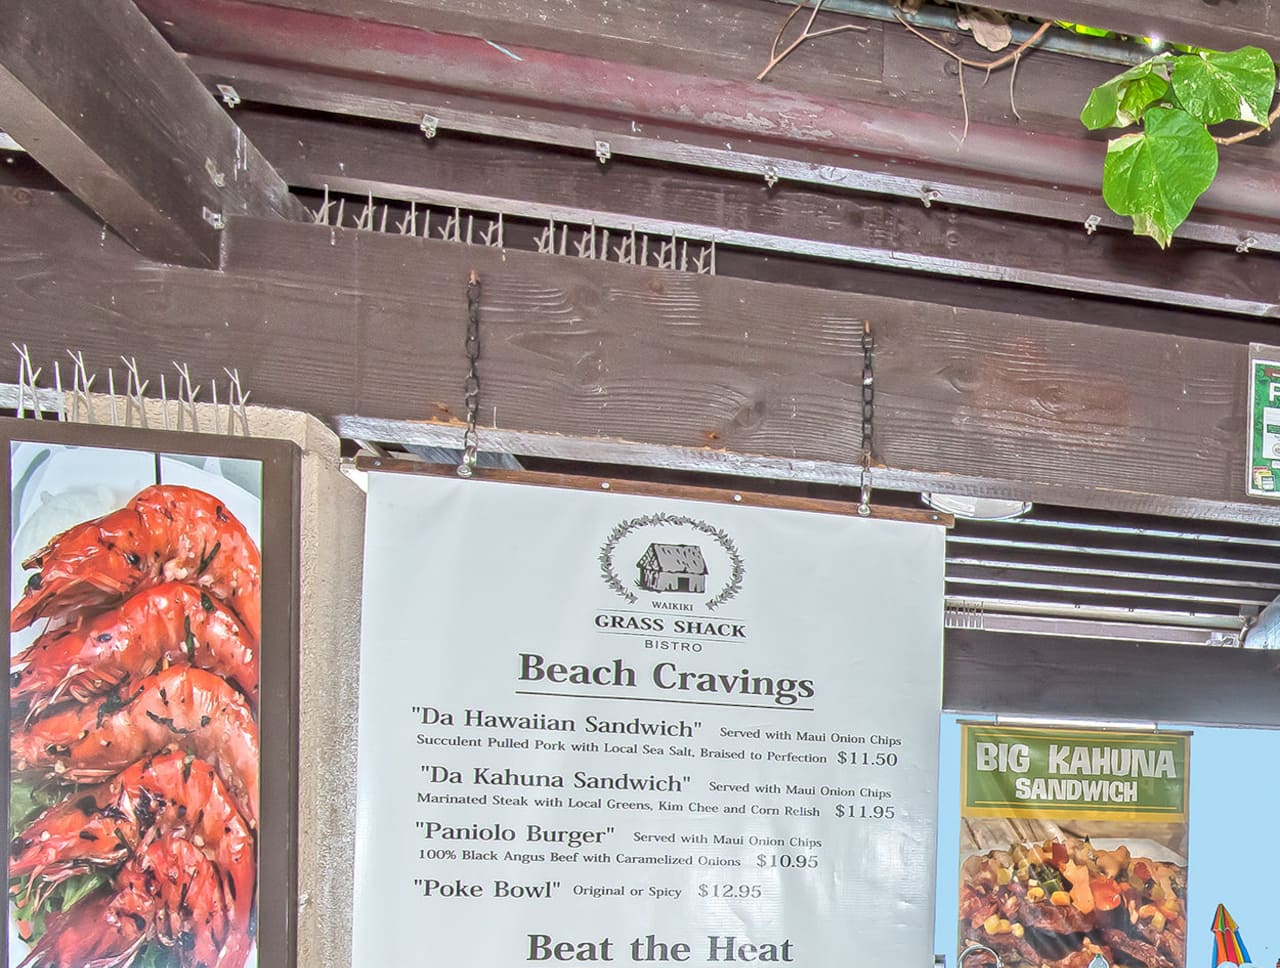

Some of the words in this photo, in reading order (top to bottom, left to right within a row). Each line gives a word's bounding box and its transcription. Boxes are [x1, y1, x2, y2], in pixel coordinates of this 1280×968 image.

[651, 600, 693, 611] WAIKIKI
[594, 614, 664, 634] GRASS
[673, 617, 746, 637] SHACK
[645, 639, 703, 652] BISTRO
[517, 653, 636, 686] Beach
[653, 662, 815, 705] Cravings
[411, 706, 453, 725] "Da
[463, 709, 575, 731] Hawaiian
[585, 715, 701, 737] Sandwich"
[719, 726, 760, 738] Served
[764, 730, 791, 740] with
[796, 731, 825, 741] Maui
[830, 732, 865, 743] Onion
[869, 734, 901, 747] Chips
[416, 733, 481, 746] Succulent
[487, 737, 528, 748] Pulled
[534, 739, 565, 750] Pork
[570, 742, 598, 752] with
[603, 742, 637, 753] Local
[642, 744, 664, 755] Sea
[668, 745, 694, 757] Salt,
[700, 747, 744, 759] Braised
[750, 751, 762, 760] to
[767, 751, 826, 763] Perfection
[837, 750, 897, 766] $11.50
[976, 742, 1030, 773] BIG
[1048, 744, 1177, 778] KAHUNA
[421, 765, 462, 783] "Da
[473, 767, 563, 787] Kahuna
[573, 771, 690, 792] Sandwich"
[708, 781, 749, 792] Served
[754, 783, 780, 793] with
[785, 784, 815, 795] Maui
[820, 786, 855, 796] Onion
[859, 787, 891, 800] Chips
[1015, 777, 1138, 802] SANDWICH
[417, 792, 486, 804] Marinated
[492, 794, 528, 806] Steak
[533, 797, 562, 807] with
[567, 797, 601, 808] Local
[606, 798, 653, 811] Greens,
[658, 800, 683, 811] Kim
[688, 801, 718, 812] Chee
[723, 804, 745, 813] and
[750, 804, 779, 815] Corn
[784, 806, 819, 816] Relish
[835, 803, 894, 819] $11.95
[415, 821, 515, 840] "Paniolo
[526, 824, 614, 848] Burger"
[633, 831, 675, 842] Served
[680, 833, 707, 843] with
[713, 834, 743, 844] Maui
[748, 836, 784, 846] Onion
[789, 837, 822, 847] Chips
[419, 849, 456, 859] 100%
[462, 849, 498, 860] Black
[503, 850, 545, 864] Angus
[550, 851, 579, 862] Beef
[582, 852, 610, 863] with
[615, 853, 692, 864] Caramelized
[697, 855, 741, 866] Onions
[756, 853, 818, 868] $10.95
[414, 879, 482, 897] "Poke
[493, 880, 560, 898] Bowl"
[572, 885, 624, 898] Original
[629, 888, 644, 896] or
[648, 886, 681, 899] Spicy
[697, 883, 761, 898] $12.95
[525, 934, 613, 961] Beat
[629, 934, 690, 961] the
[706, 935, 793, 961] Heat
